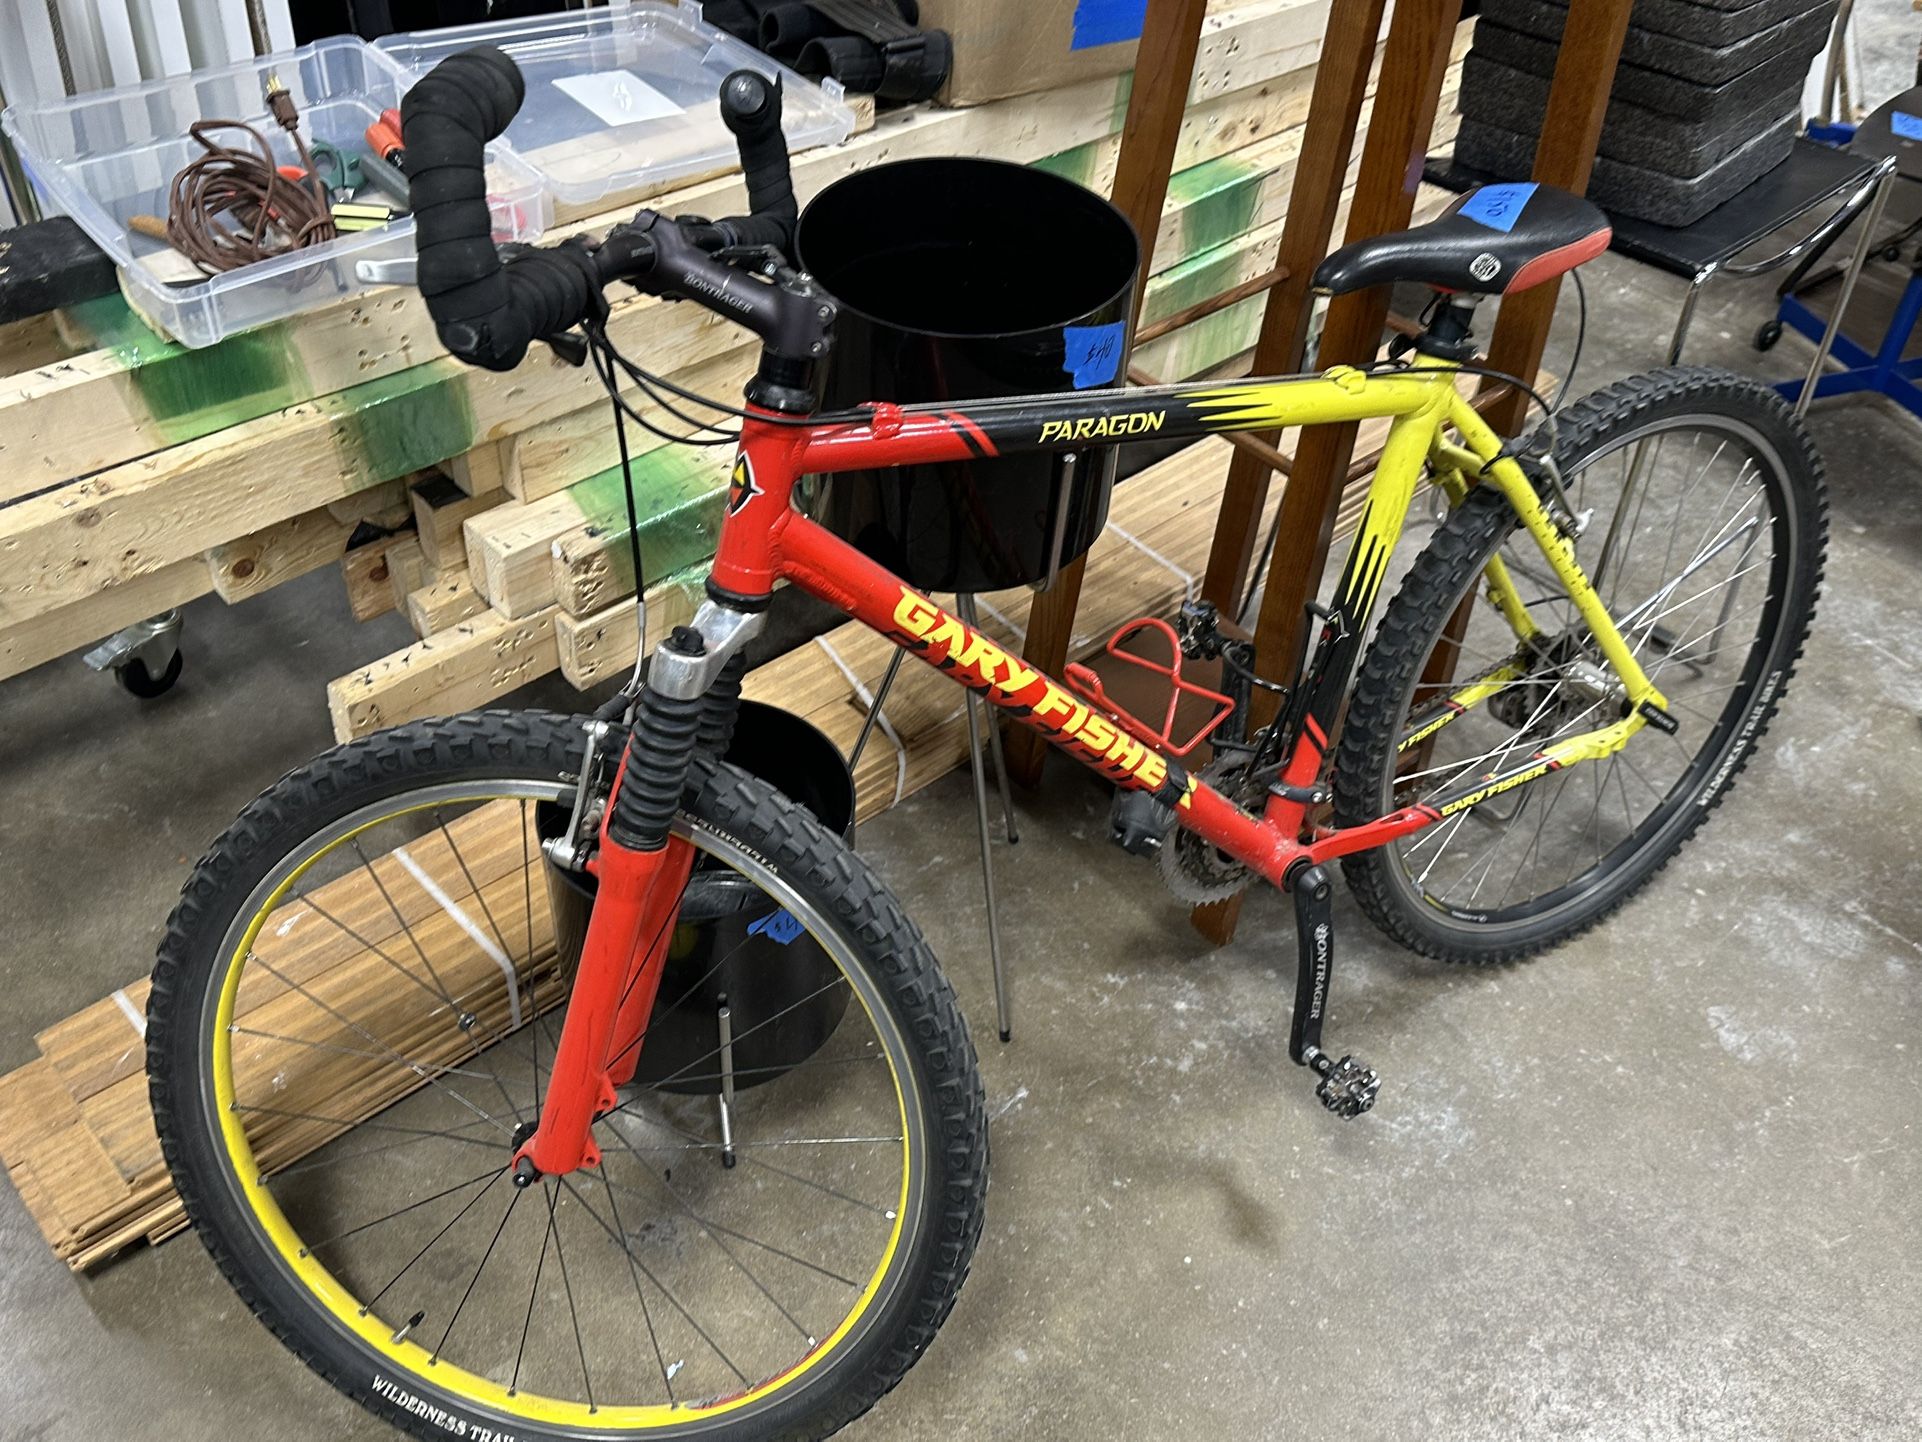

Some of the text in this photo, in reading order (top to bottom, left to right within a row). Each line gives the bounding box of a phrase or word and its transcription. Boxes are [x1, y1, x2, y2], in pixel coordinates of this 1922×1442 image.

[683, 270, 755, 314] BONTRAGER
[1038, 409, 1167, 444] PARAGON
[893, 585, 1039, 693] GARY
[1441, 763, 1549, 817] GARY FISHER
[1310, 922, 1330, 1020] BONTRAGER
[371, 1374, 468, 1436] WILDERNESS
